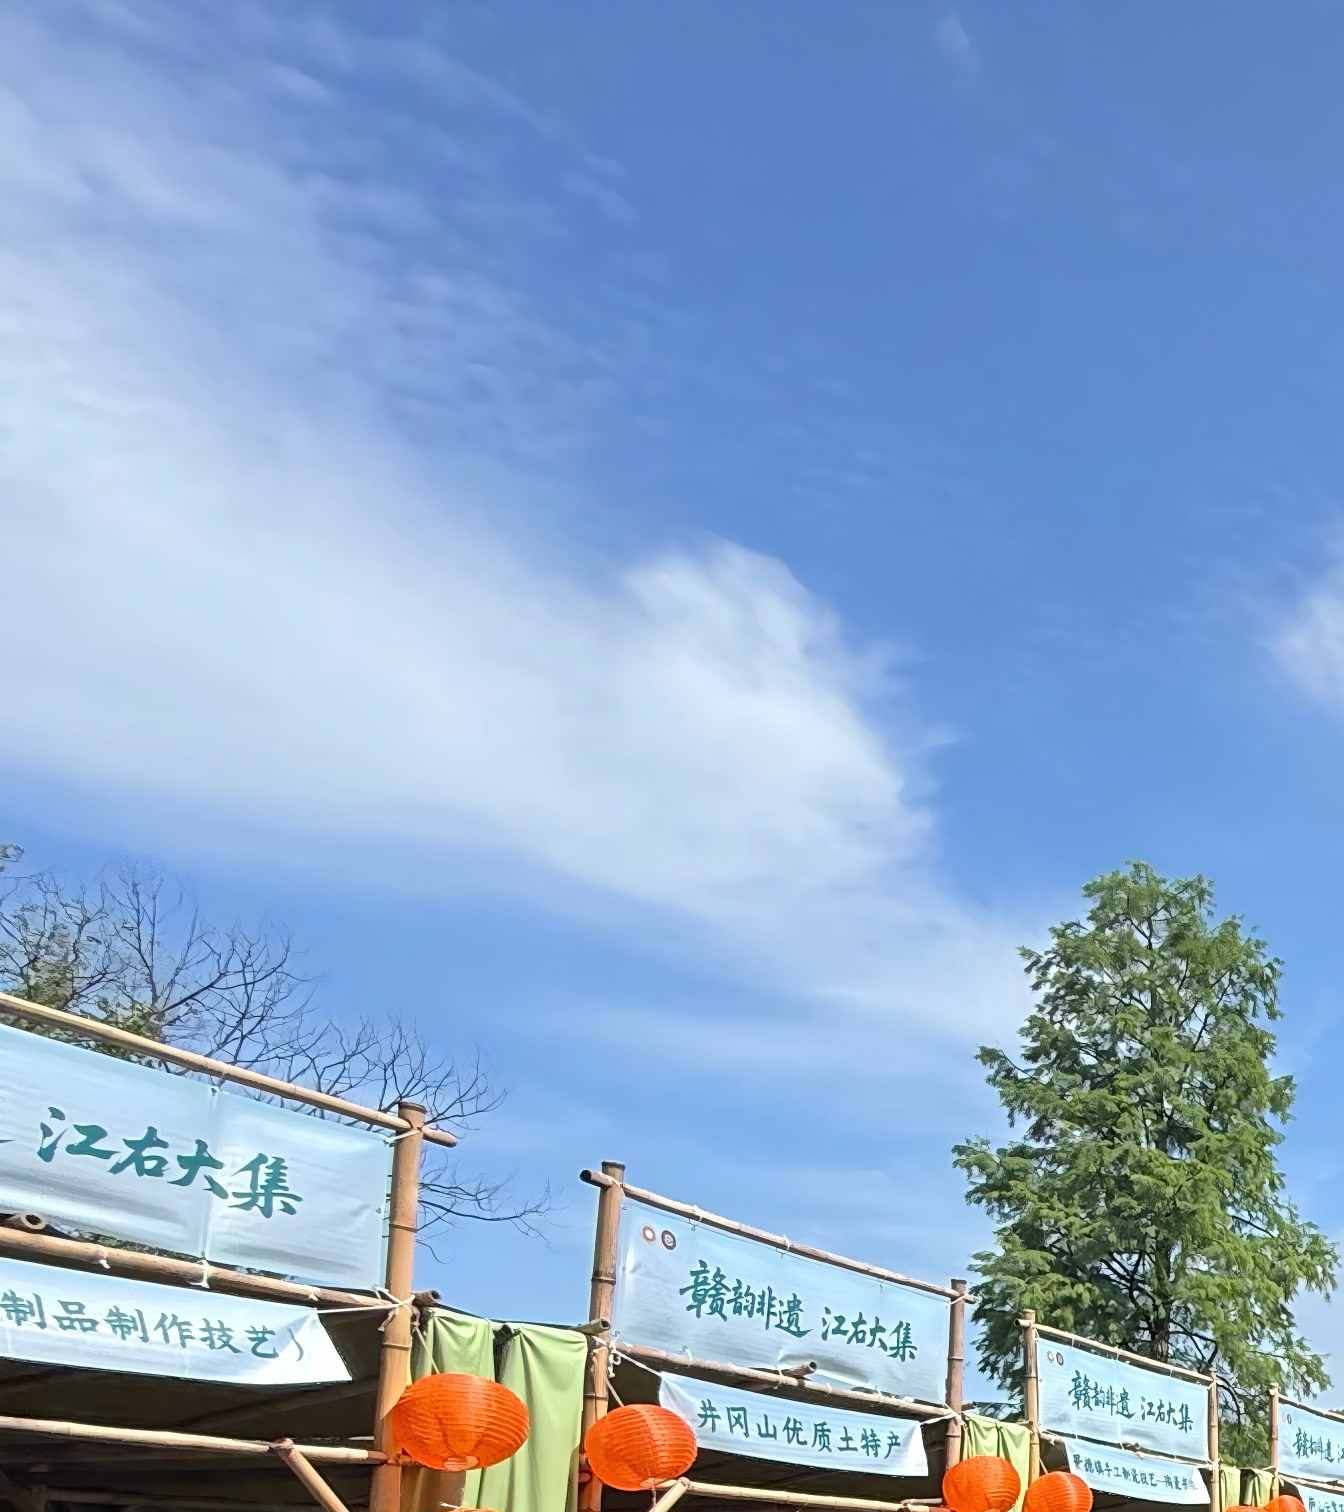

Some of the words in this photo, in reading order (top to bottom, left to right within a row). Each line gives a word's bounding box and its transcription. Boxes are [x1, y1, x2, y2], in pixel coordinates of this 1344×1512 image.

[37, 1107, 303, 1218] 江右大集
[679, 1260, 813, 1337] 赣韵非遗
[821, 1306, 917, 1362] 江右大集
[697, 1399, 900, 1459] 井冈山优质土特产
[1141, 1396, 1194, 1433] 江右大集
